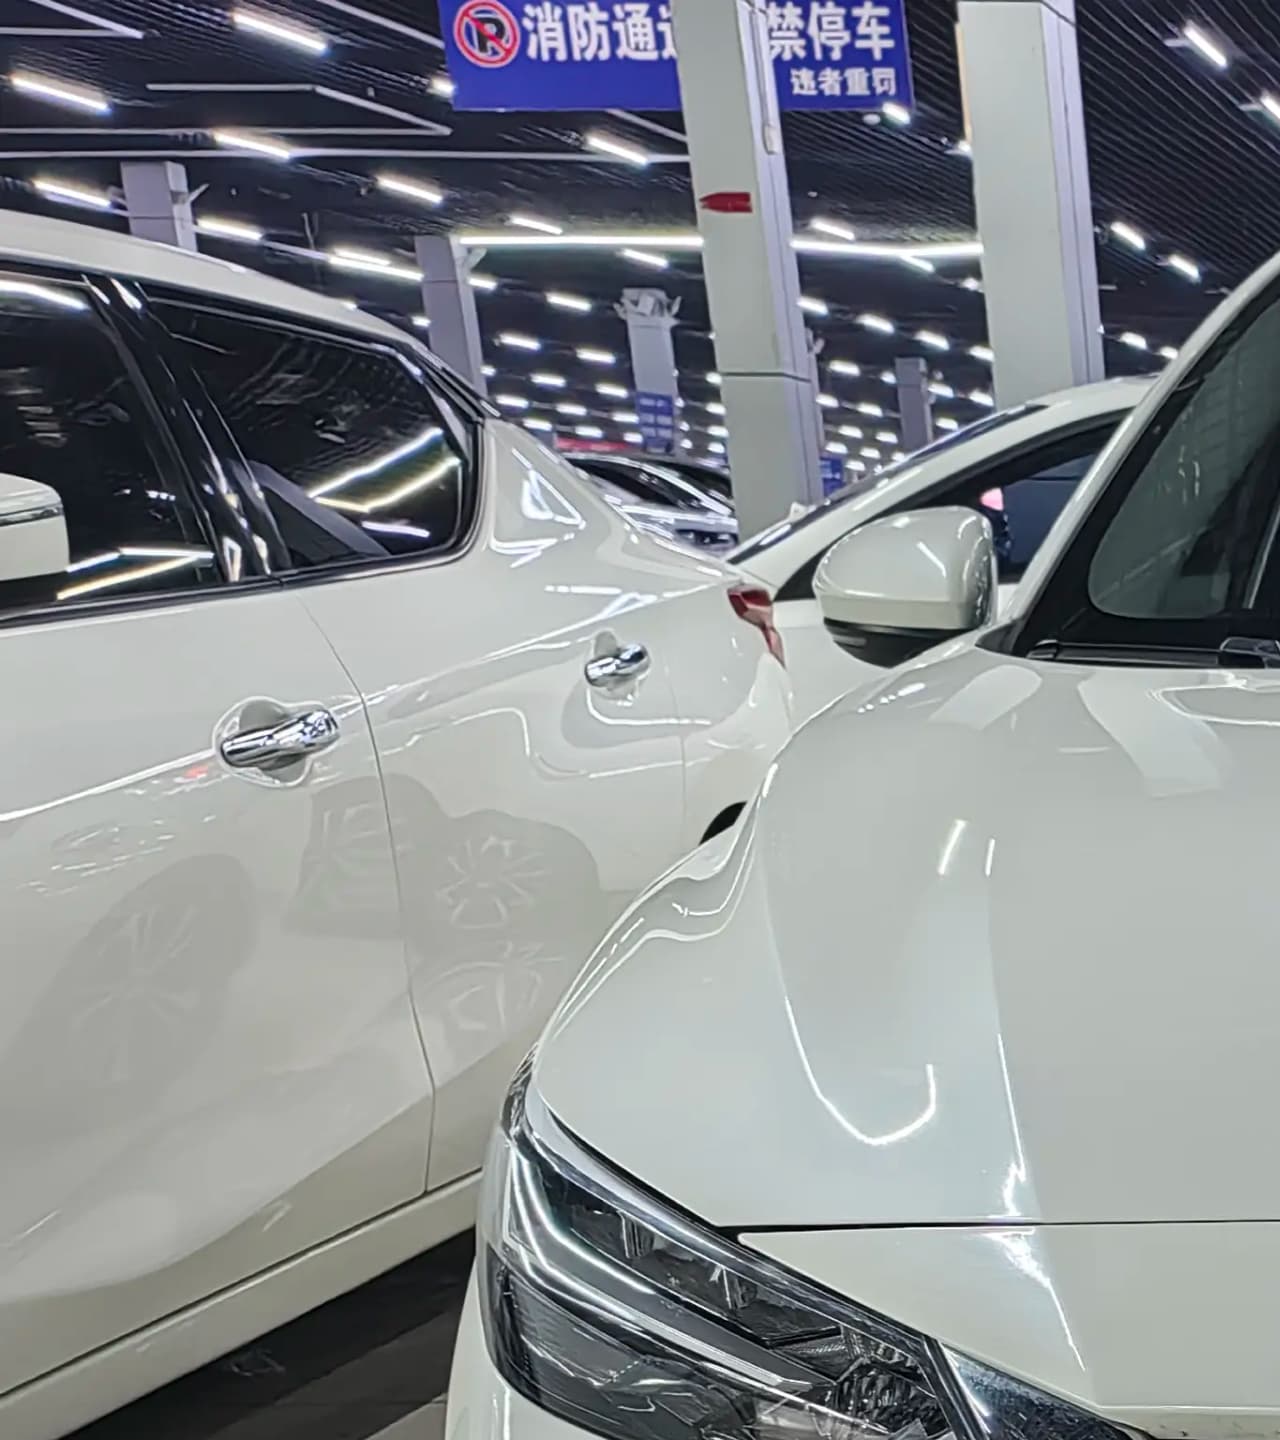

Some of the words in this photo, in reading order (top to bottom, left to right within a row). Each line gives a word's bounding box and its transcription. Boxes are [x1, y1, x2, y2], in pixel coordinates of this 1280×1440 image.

[767, 1, 895, 61] 禁停车
[790, 67, 896, 96] 违者重罚
